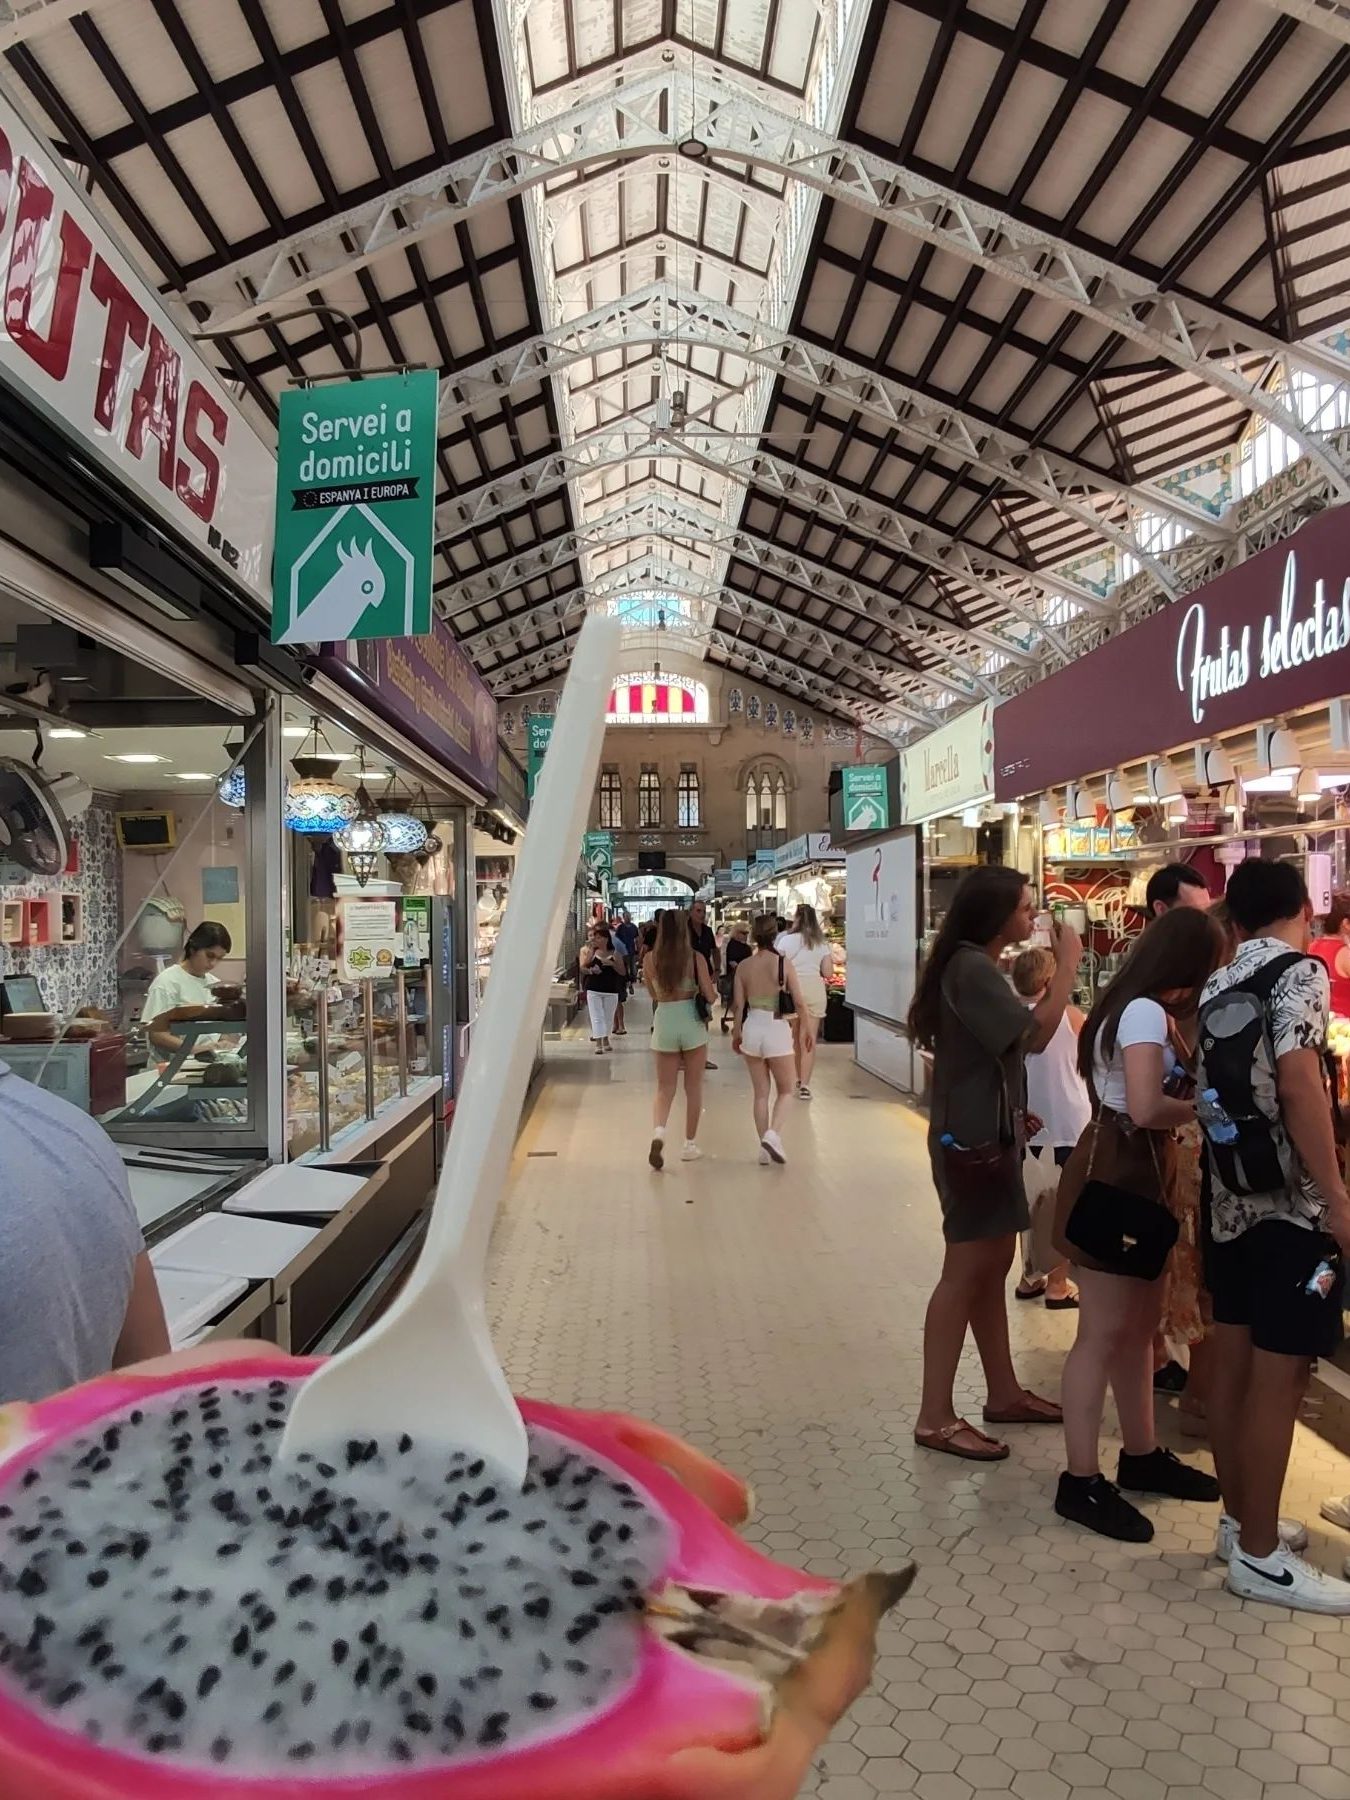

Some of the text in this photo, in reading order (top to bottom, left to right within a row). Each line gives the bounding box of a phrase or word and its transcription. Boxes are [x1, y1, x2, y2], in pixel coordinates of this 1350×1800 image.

[0, 127, 228, 524] UTAS
[302, 403, 411, 444] Servei a
[300, 439, 411, 482] domicili
[319, 483, 410, 504] ESPANYA I EUROPA
[1259, 550, 1350, 679] selectas
[532, 725, 552, 737] Ser
